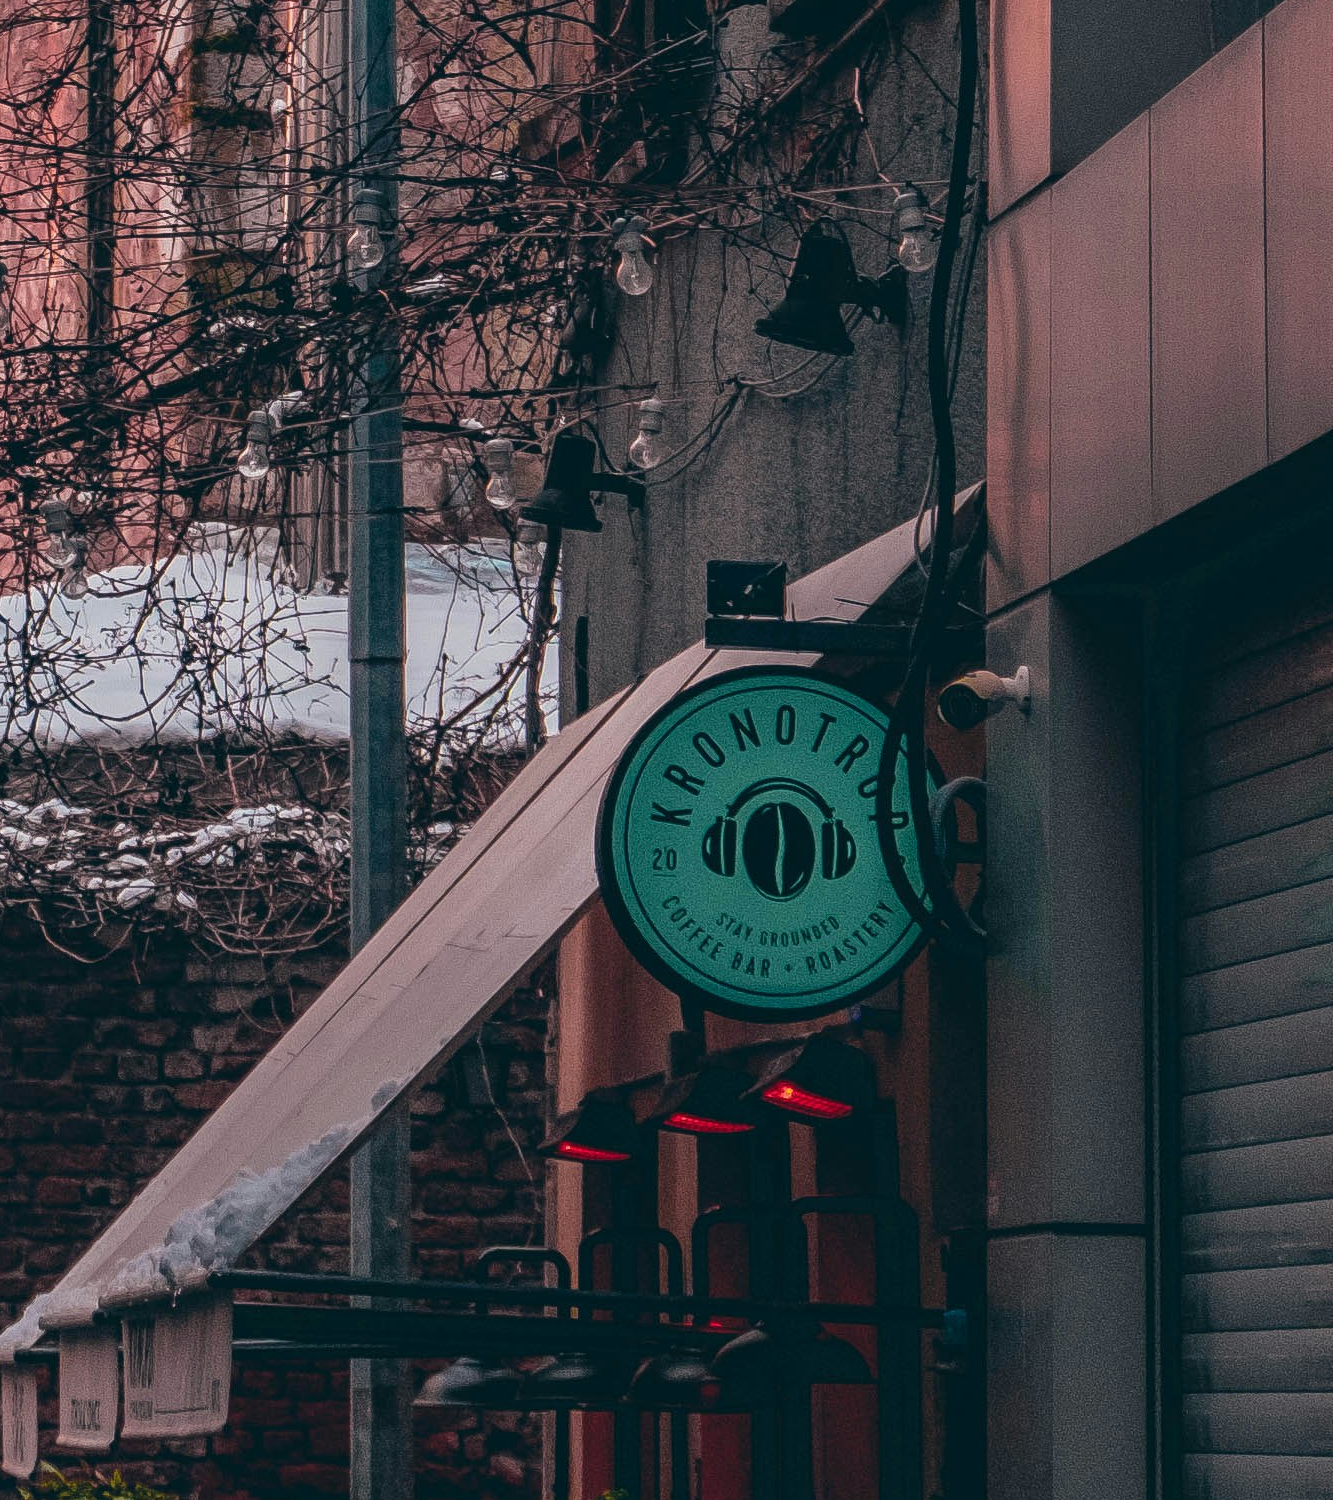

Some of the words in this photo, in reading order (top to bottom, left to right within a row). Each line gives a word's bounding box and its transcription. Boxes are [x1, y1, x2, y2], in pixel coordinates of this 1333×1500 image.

[652, 848, 677, 871] 20
[662, 896, 725, 961] COFFEE
[731, 956, 771, 978] BAR
[805, 900, 895, 975] ROASTERY
[716, 912, 754, 942] STAY
[760, 915, 840, 948] GROUNDED
